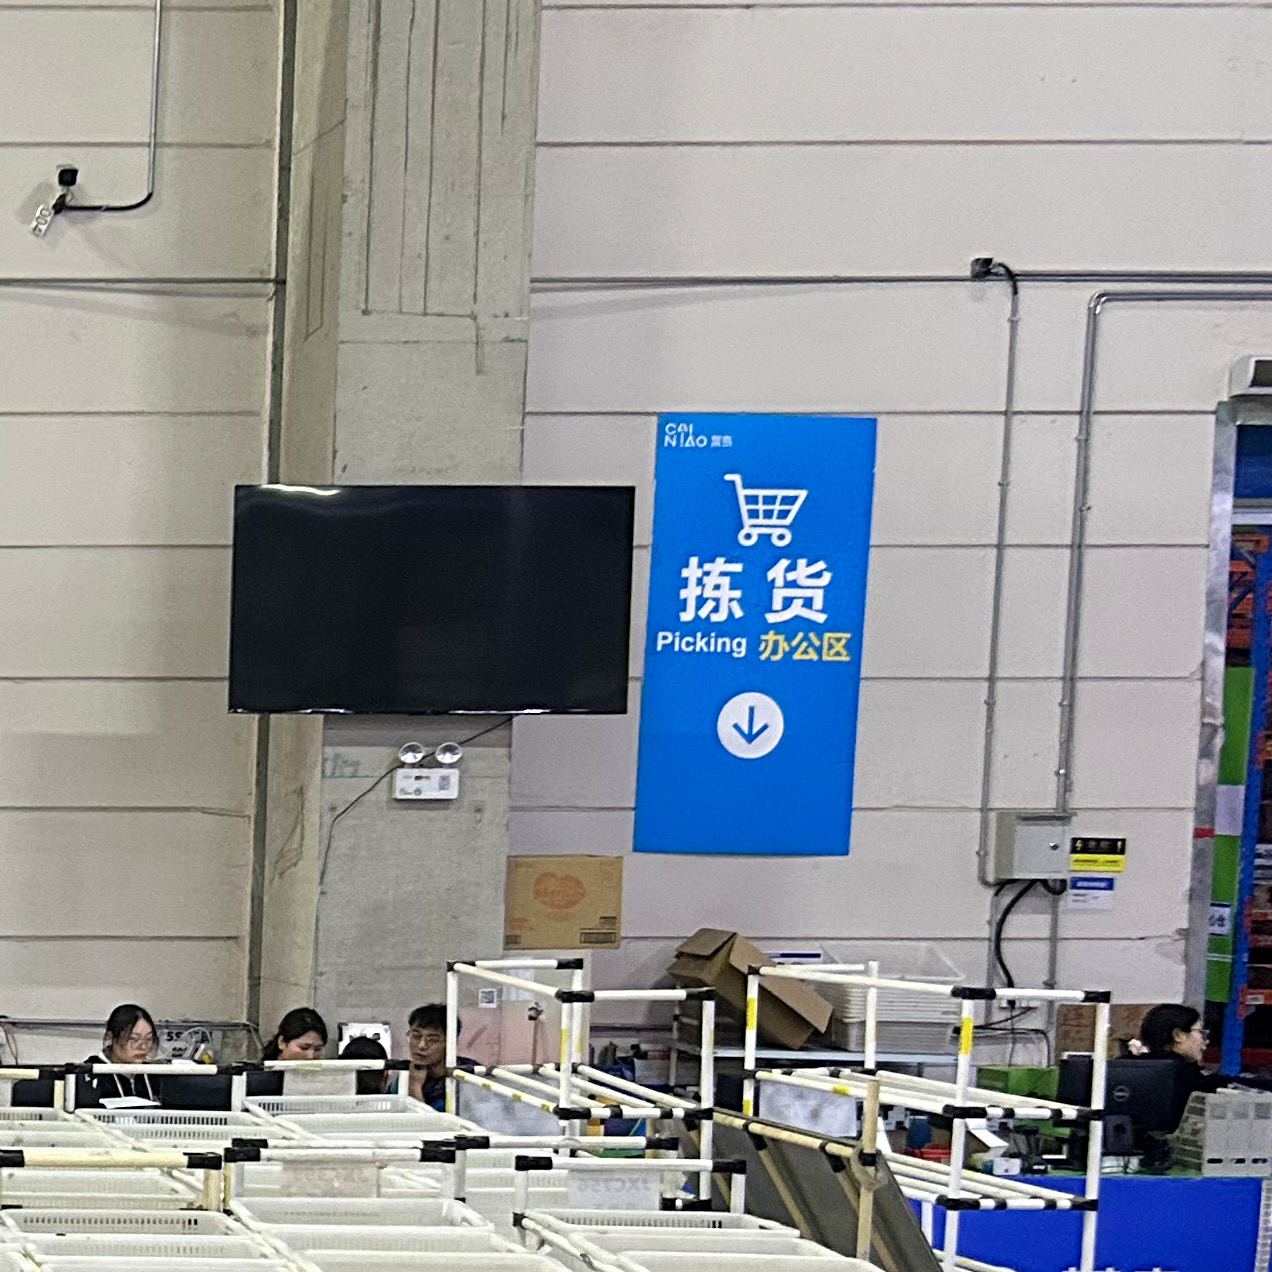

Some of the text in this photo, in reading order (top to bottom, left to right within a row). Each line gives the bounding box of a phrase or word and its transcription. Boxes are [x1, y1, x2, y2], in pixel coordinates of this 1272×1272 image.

[679, 556, 833, 623] 拣货
[656, 631, 851, 662] Picking 办公区
